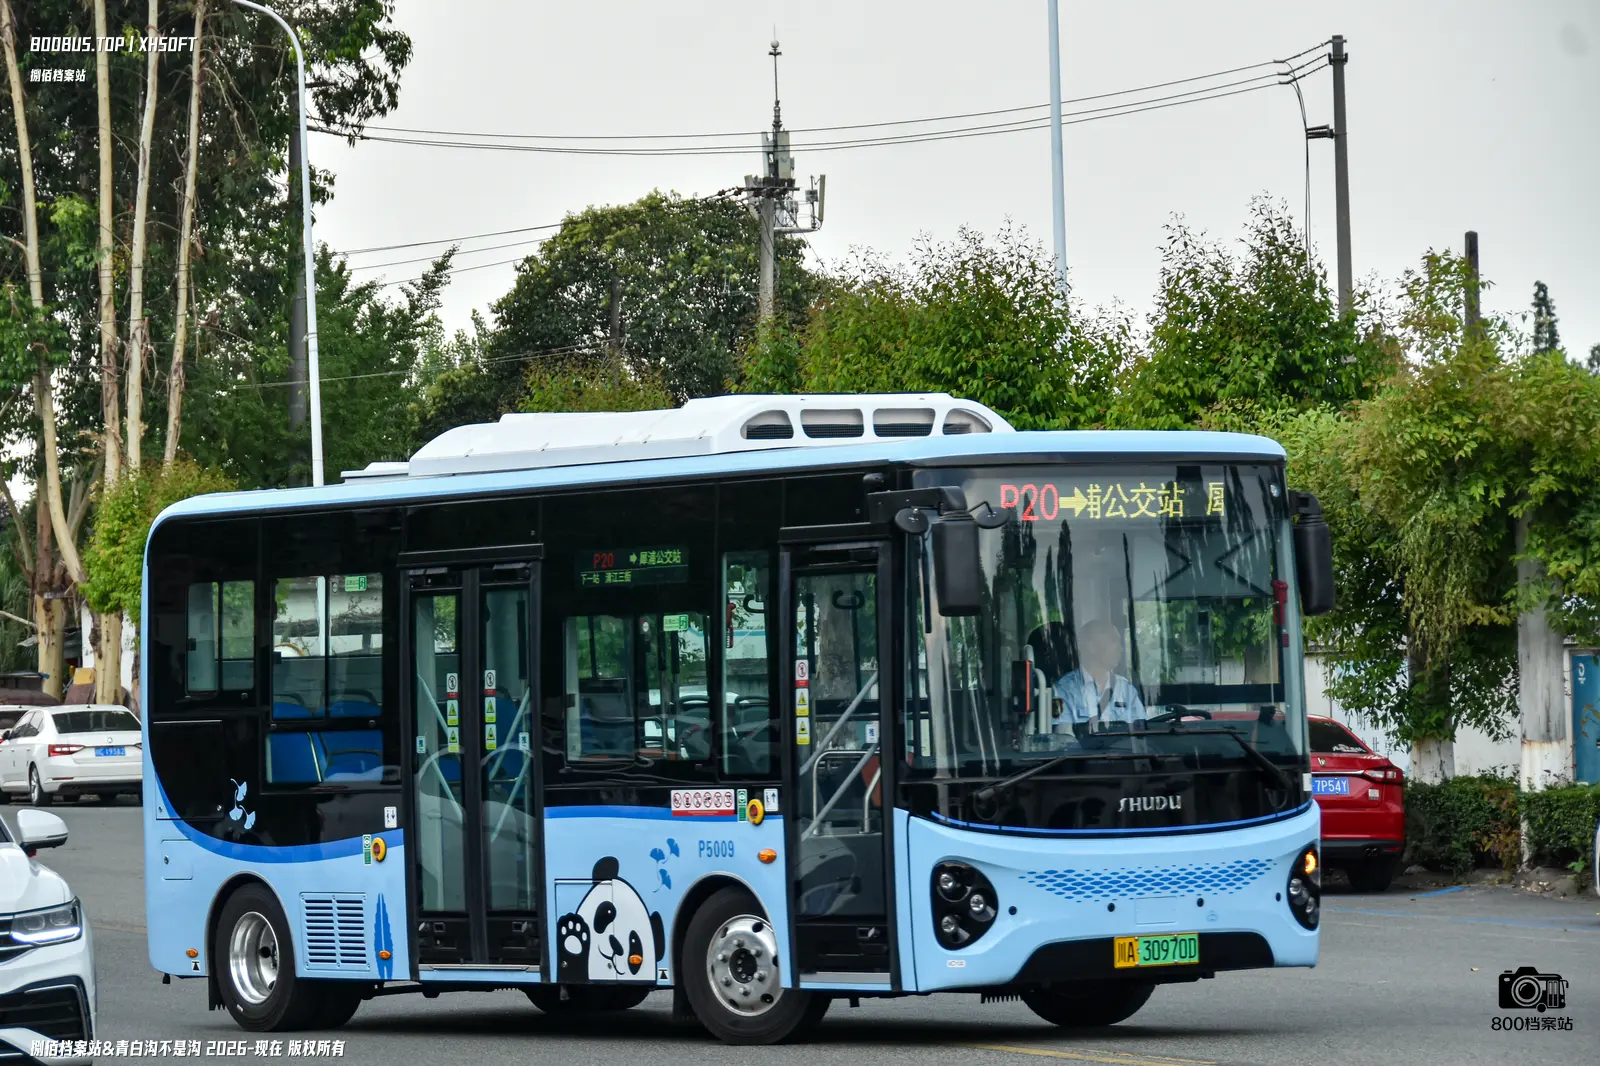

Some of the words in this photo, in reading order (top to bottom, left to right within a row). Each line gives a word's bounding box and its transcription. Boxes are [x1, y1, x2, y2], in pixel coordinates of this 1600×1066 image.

[1000, 483, 1059, 521] P20
[593, 552, 614, 568] P20
[1314, 778, 1348, 794] 7P54Y
[1117, 795, 1182, 812] SHUDU
[698, 839, 735, 858] P5009
